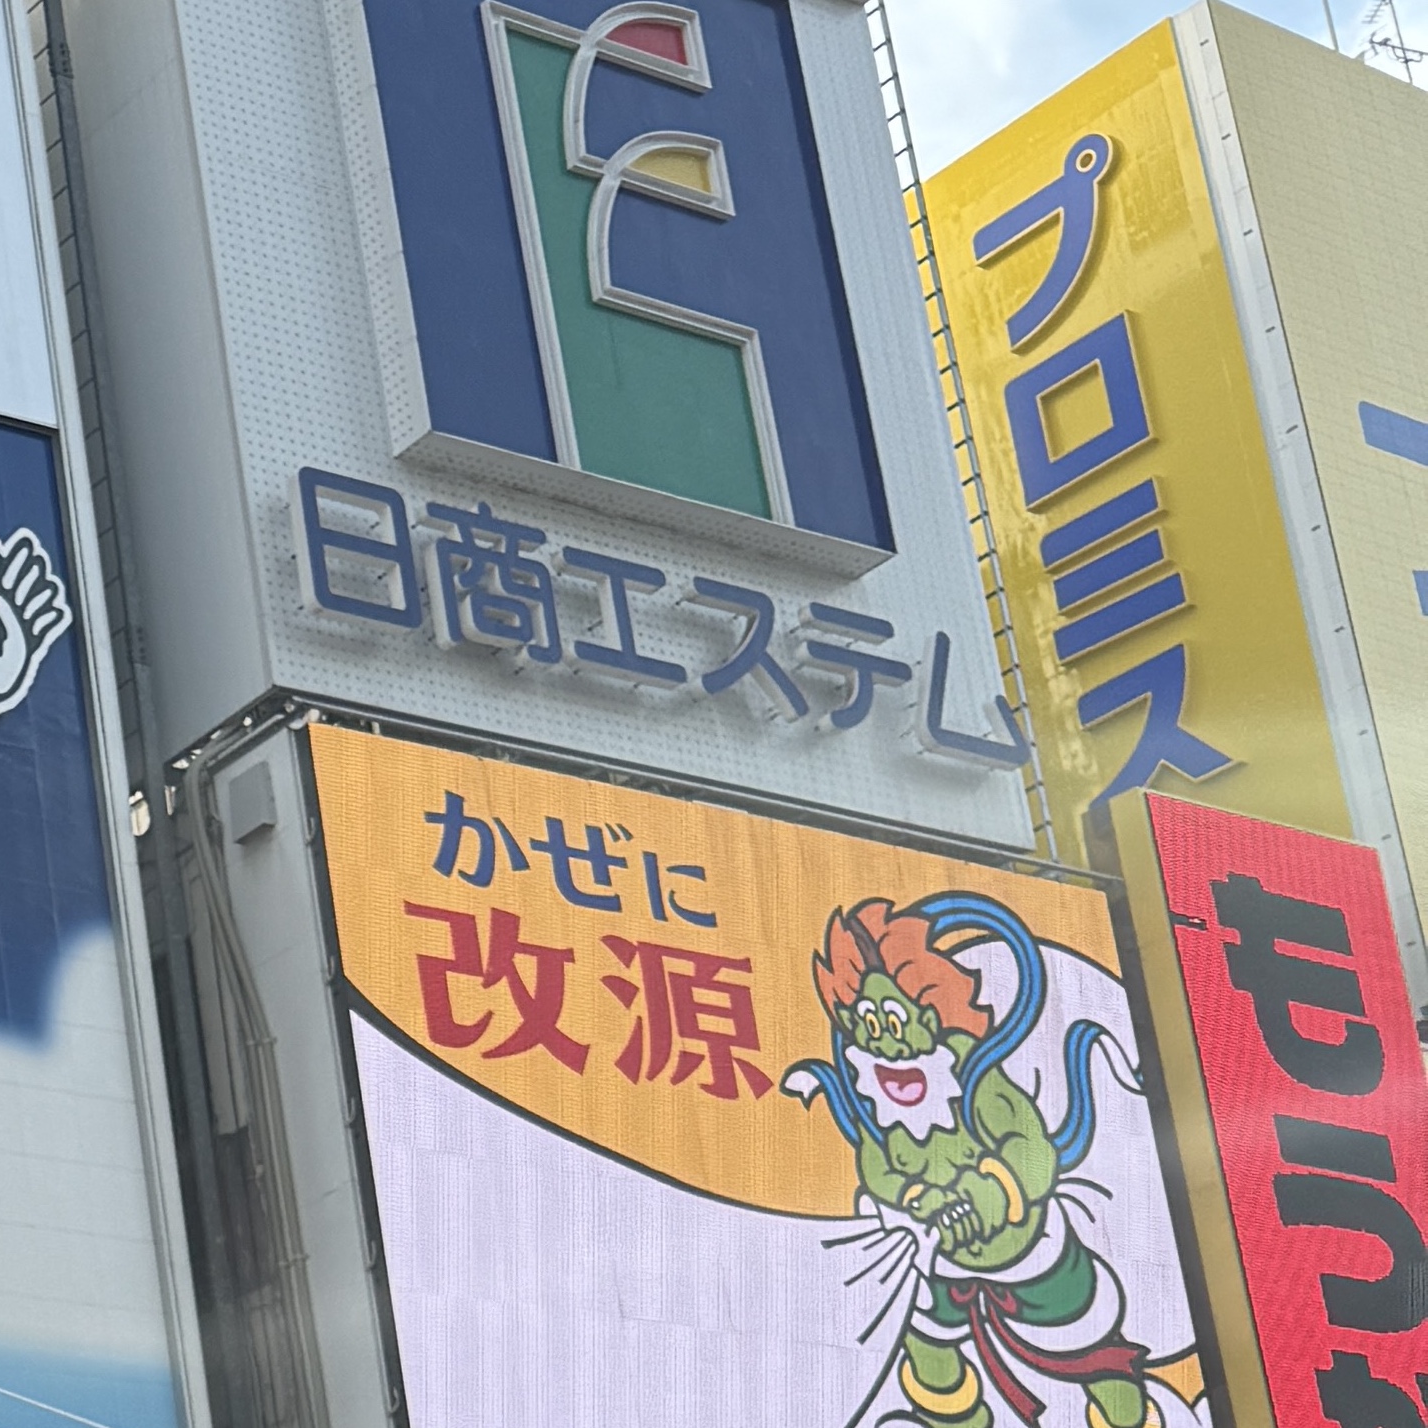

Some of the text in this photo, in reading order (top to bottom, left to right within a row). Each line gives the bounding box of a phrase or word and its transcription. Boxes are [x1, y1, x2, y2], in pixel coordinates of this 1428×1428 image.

[974, 132, 1245, 807] プロミス
[295, 466, 1031, 770] 日商エステム
[424, 790, 718, 929] かぜに
[404, 900, 775, 1101] 改源
